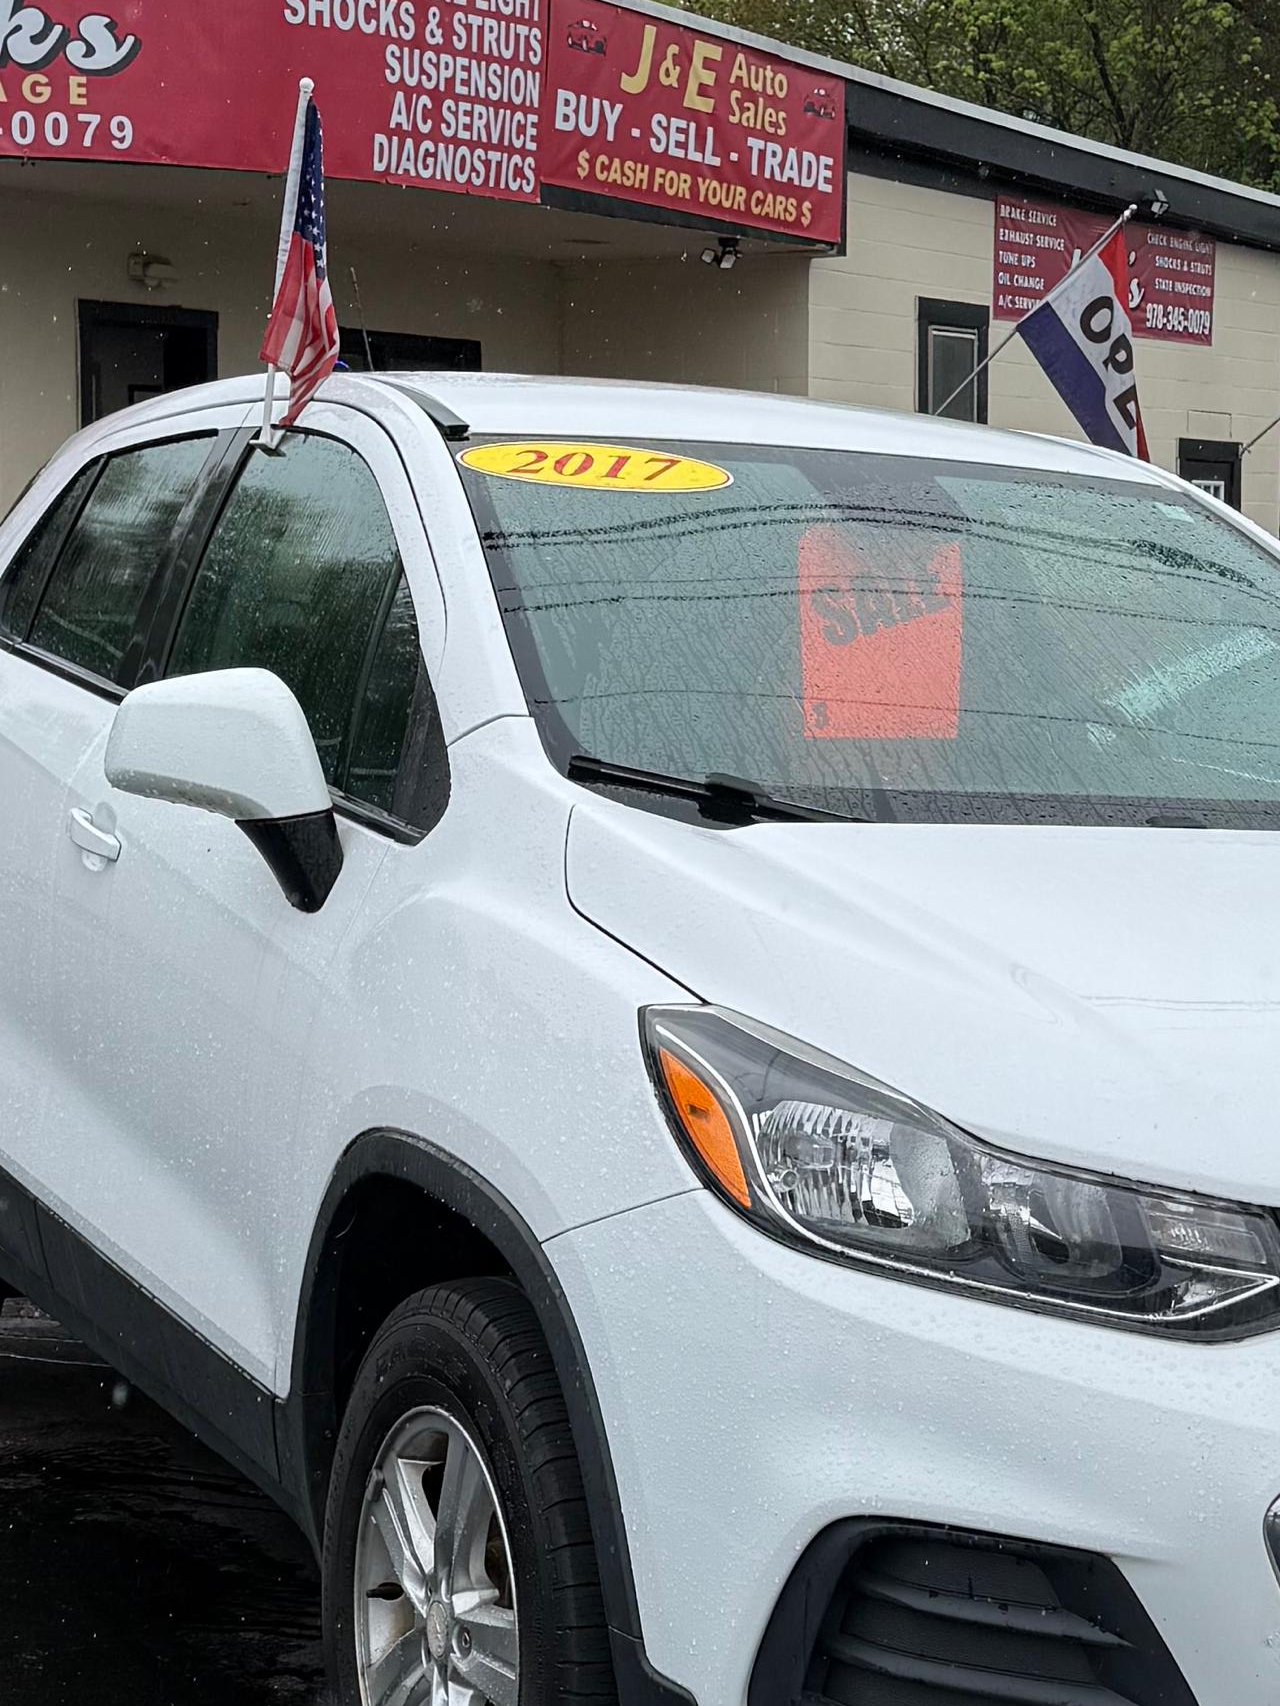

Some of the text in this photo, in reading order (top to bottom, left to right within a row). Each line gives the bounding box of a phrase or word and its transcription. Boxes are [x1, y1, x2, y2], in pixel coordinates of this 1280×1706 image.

[425, 6, 443, 46] &
[452, 11, 542, 65] STRUTS
[385, 44, 540, 108] SUSPENSION
[729, 53, 788, 99] Auto
[389, 91, 538, 151] A/C SERVICE
[729, 90, 787, 136] Sales
[555, 89, 623, 141] BUY
[650, 113, 721, 167] SELL
[747, 137, 833, 193] TRADE
[373, 133, 536, 193] DIAGNOSTICS
[577, 149, 812, 228] $ CASH FOR YOUR CARS $
[1000, 204, 1057, 226] BRAKE SERVICE
[999, 228, 1065, 251] EXHAUST SERVICE
[1147, 233, 1167, 247] CHECK
[999, 251, 1036, 268] TUNE UPS
[998, 272, 1045, 290] OIL CHANGE
[1155, 278, 1172, 291] STATE
[998, 295, 1041, 310] A/C SERVI
[1146, 303, 1210, 335] 978-345-0079
[507, 449, 682, 481] 2017
